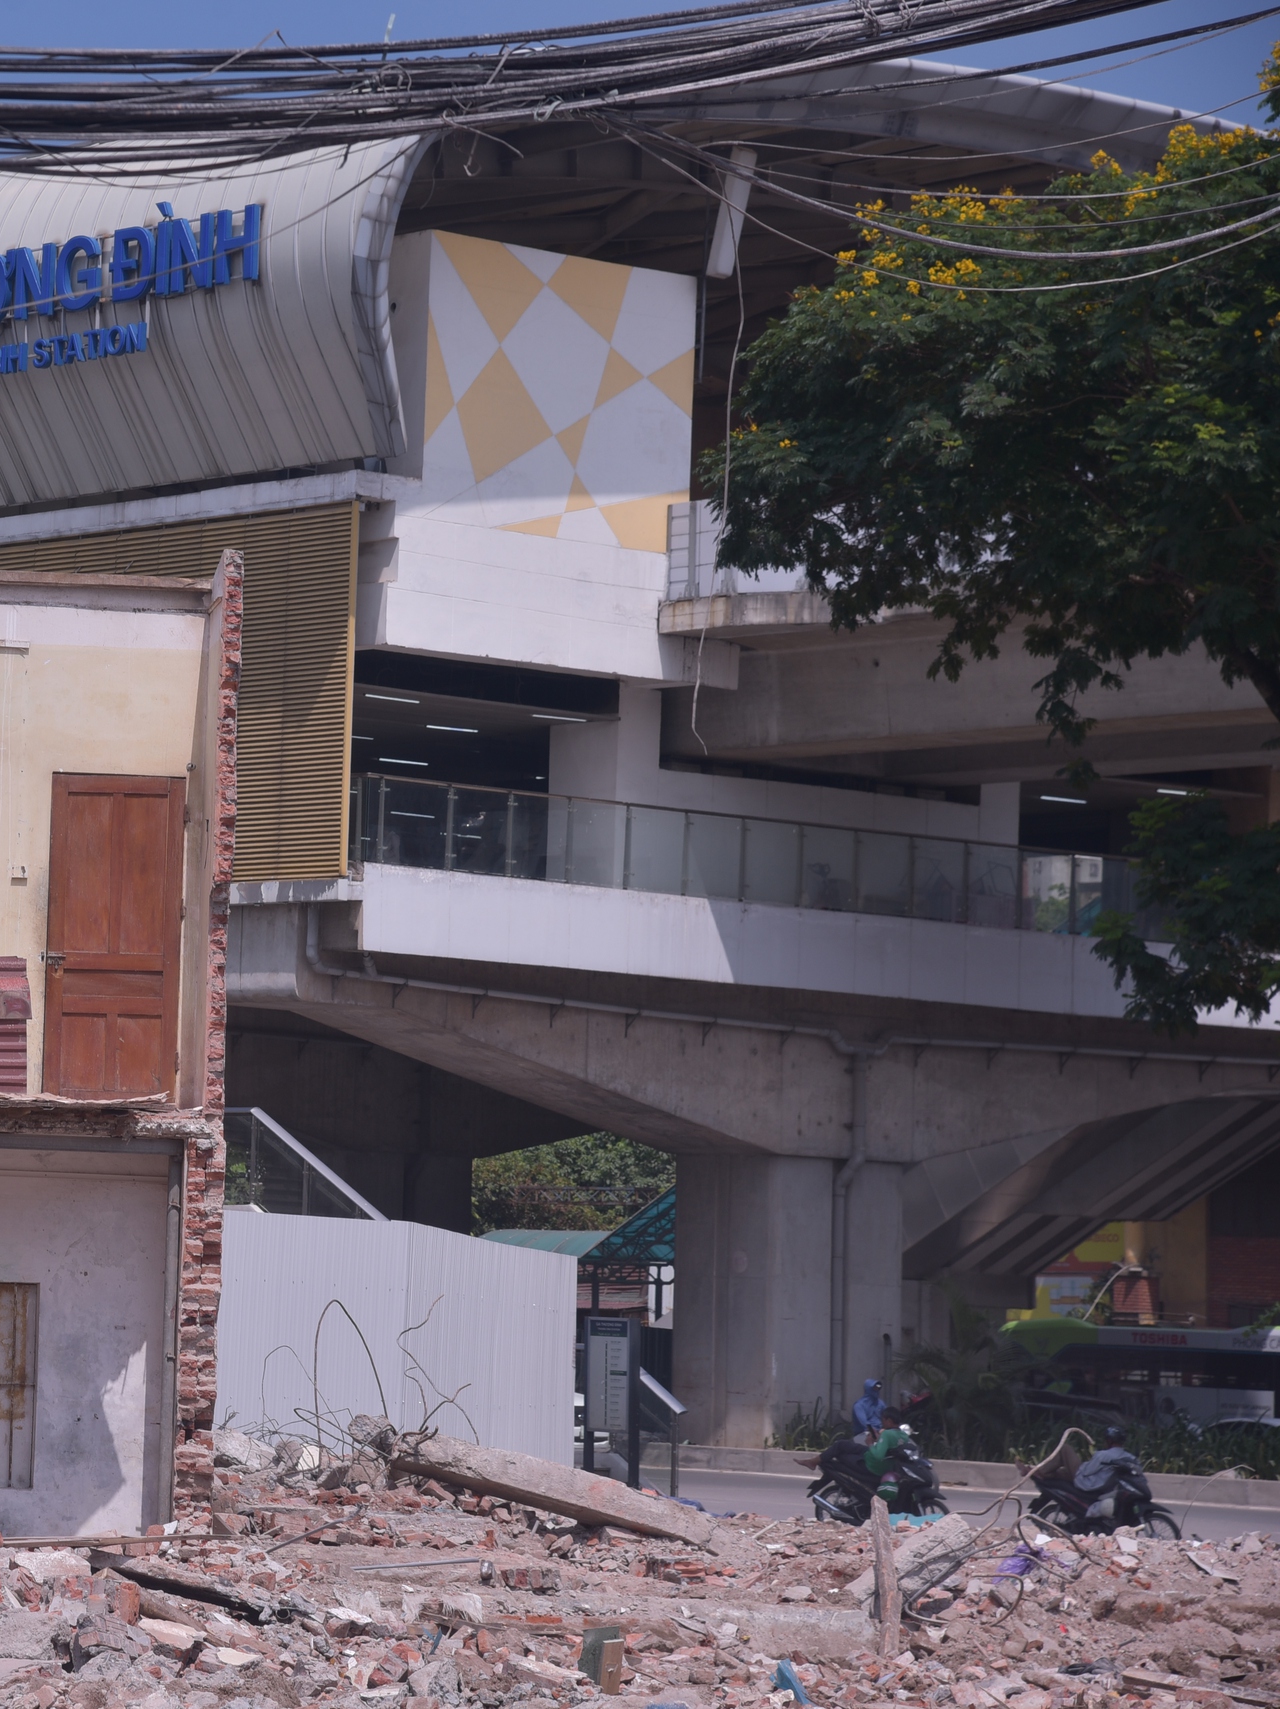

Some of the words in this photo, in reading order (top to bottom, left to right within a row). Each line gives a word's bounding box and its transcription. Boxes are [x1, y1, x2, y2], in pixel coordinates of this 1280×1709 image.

[109, 201, 262, 302] ĐÌNH
[33, 320, 148, 370] STATION
[1131, 1332, 1188, 1346] TOSHIBA
